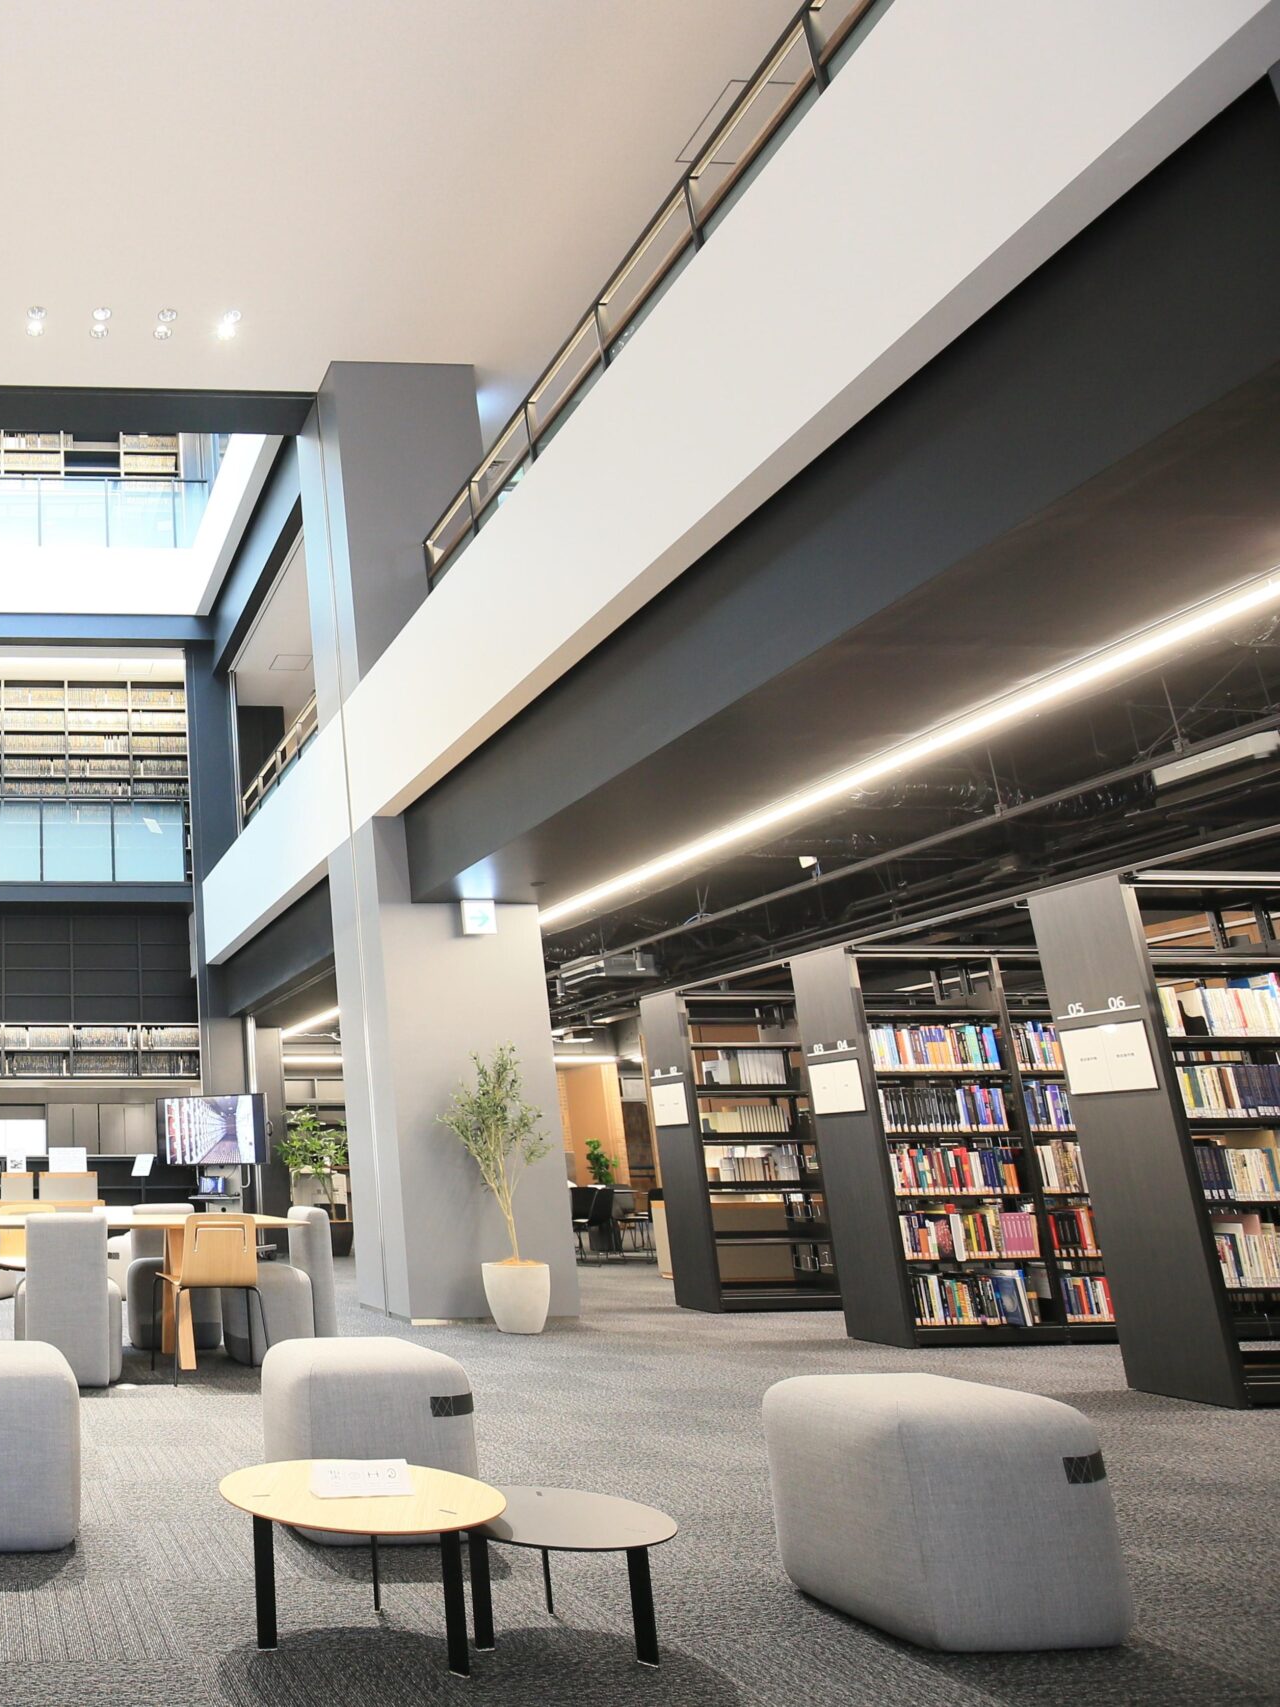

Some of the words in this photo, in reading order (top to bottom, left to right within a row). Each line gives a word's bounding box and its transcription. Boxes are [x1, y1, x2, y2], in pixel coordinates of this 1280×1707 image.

[1067, 1002, 1084, 1015] 05
[1108, 995, 1126, 1008] 06
[813, 1043, 824, 1053] 03
[836, 1039, 848, 1049] 04
